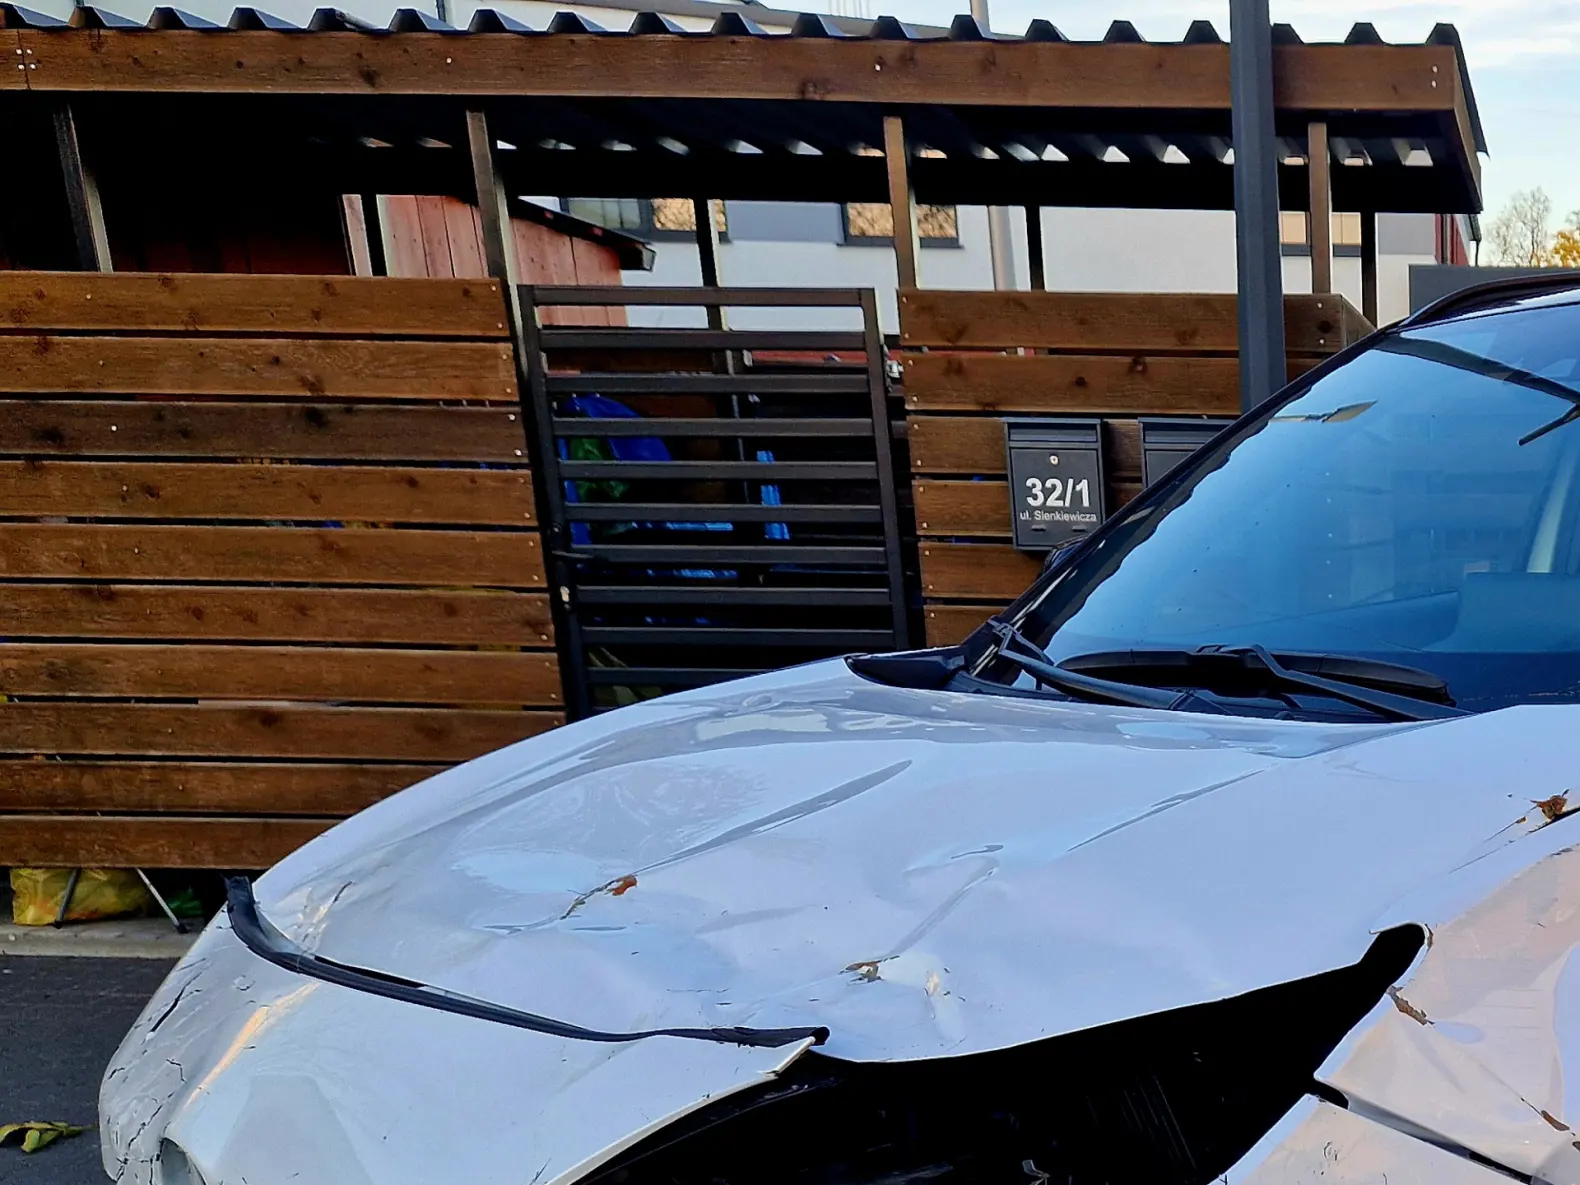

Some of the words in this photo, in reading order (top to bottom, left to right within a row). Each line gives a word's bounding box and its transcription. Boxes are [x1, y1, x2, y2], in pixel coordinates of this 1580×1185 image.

[1025, 477, 1090, 507] 32/1
[1019, 510, 1032, 520] ul.
[1034, 510, 1097, 522] Sienkiewicza
